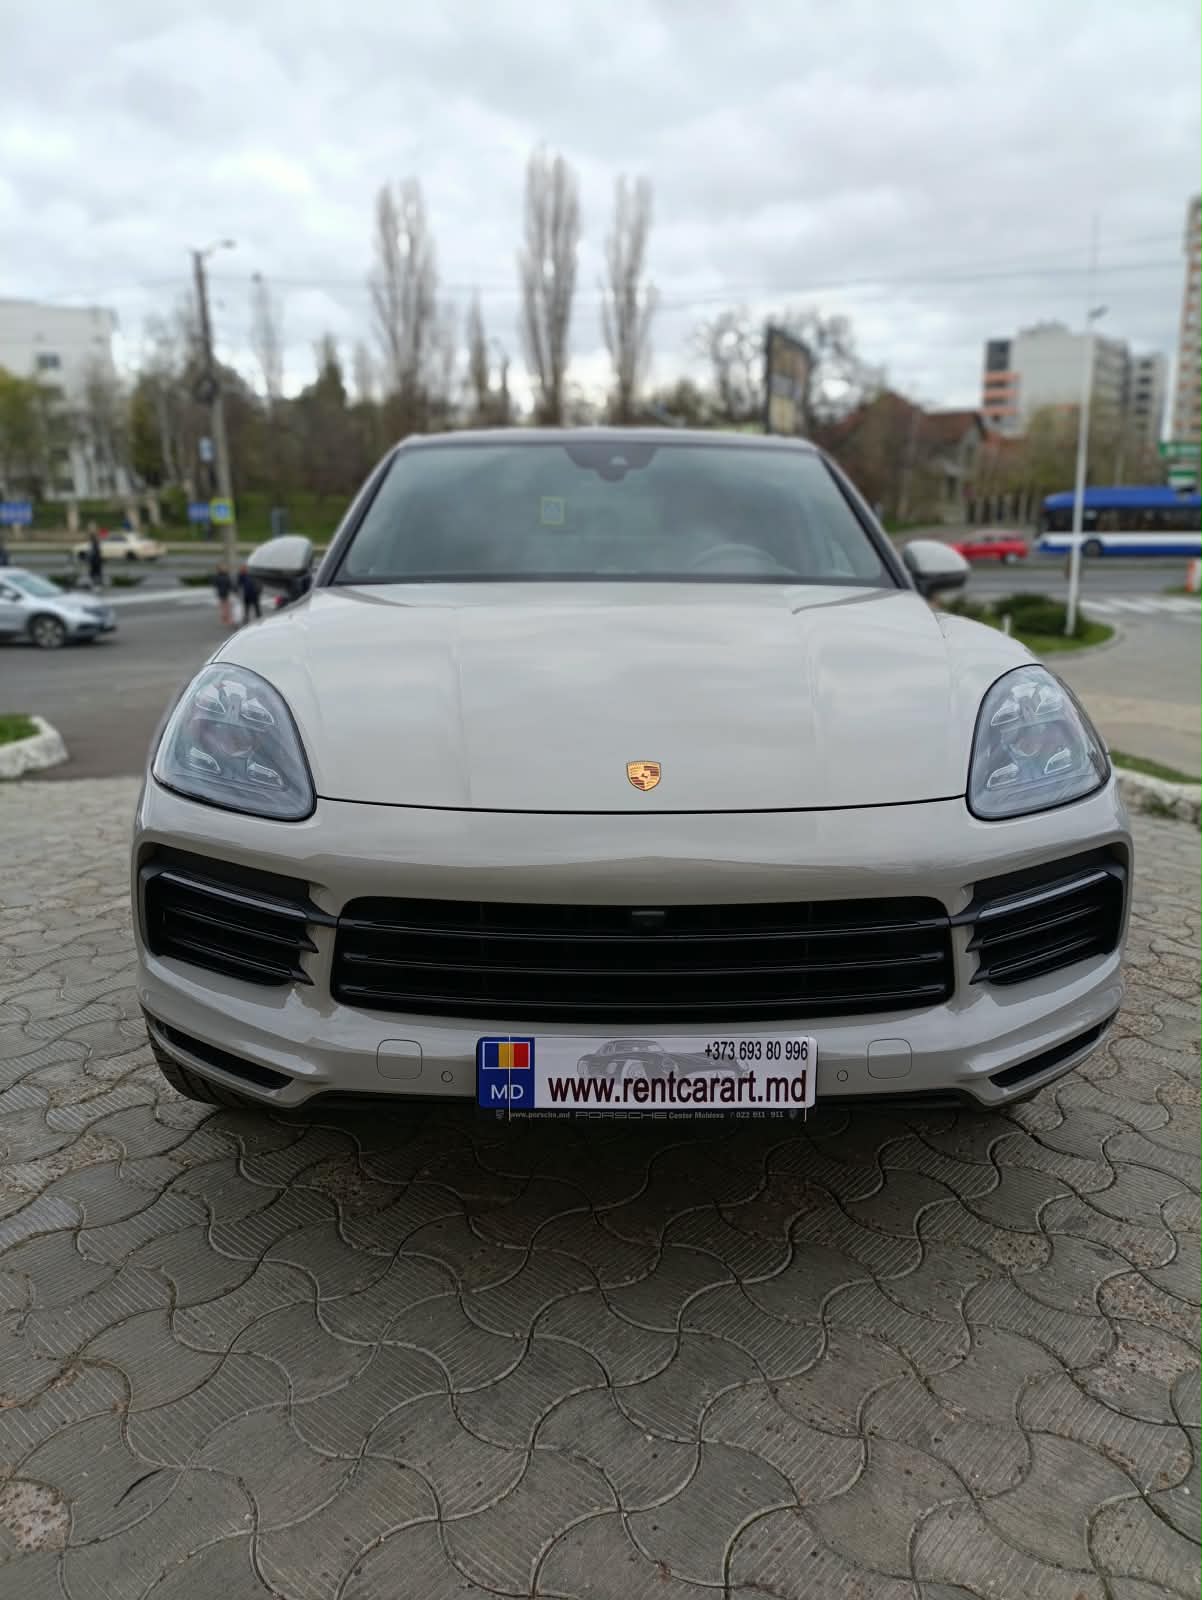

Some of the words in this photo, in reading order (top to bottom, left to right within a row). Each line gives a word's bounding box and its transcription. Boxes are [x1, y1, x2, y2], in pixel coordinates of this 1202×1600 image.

[705, 1041, 735, 1061] +373
[739, 1041, 762, 1061] 693
[766, 1040, 781, 1061] 80
[785, 1041, 808, 1061] 996
[491, 1084, 524, 1100] MD
[548, 1069, 807, 1103] www.rentcarart.md
[575, 1111, 667, 1119] PORSCHE
